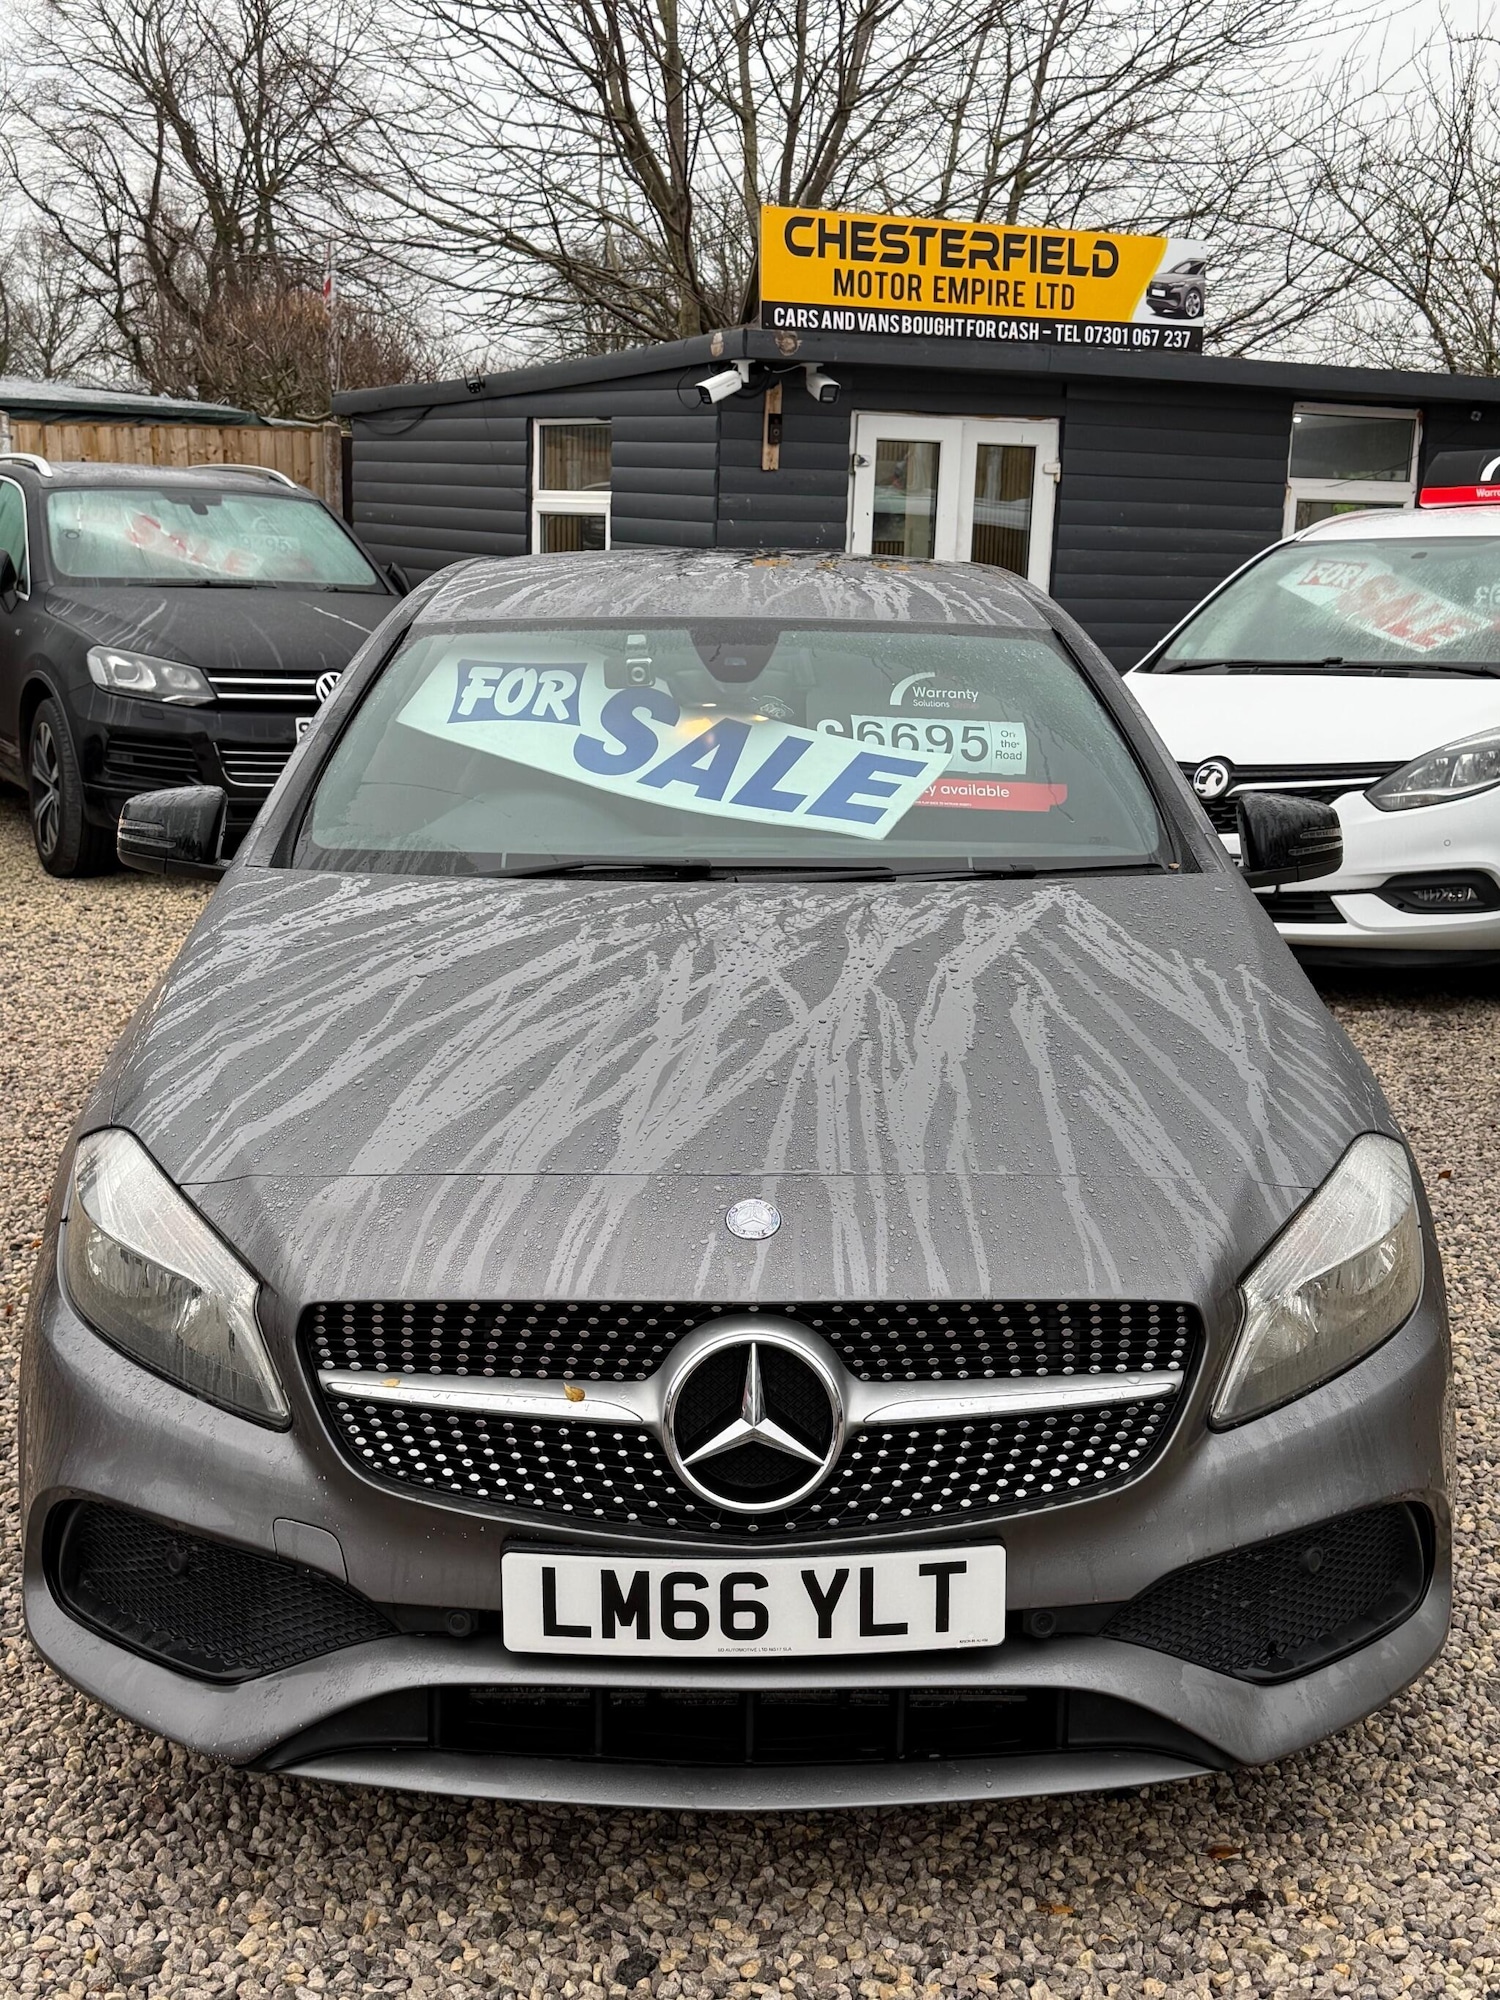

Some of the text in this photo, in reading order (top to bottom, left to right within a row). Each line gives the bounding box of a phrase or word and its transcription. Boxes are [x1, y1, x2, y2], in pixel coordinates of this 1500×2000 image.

[784, 216, 1120, 278] CHESTERFIELD
[833, 268, 1075, 311] MOTOR EMPIRE LTD
[773, 307, 819, 328] CARS
[821, 310, 855, 331] AND
[856, 312, 900, 333] VANS
[901, 315, 967, 337] BOUGHT
[967, 319, 997, 339] FOR
[998, 320, 1040, 341] CASH
[1055, 324, 1081, 343] TEL
[1084, 326, 1128, 345] 07301
[1132, 328, 1160, 347] 067
[1163, 330, 1191, 348] 237
[1302, 562, 1362, 589] FOR
[1337, 574, 1485, 648] SALE
[912, 686, 979, 703] Warranty
[912, 698, 951, 709] Solutions
[457, 666, 930, 824] FOR SALE
[1000, 730, 1016, 738] On
[995, 750, 1022, 760] Road
[941, 782, 1010, 798] available
[542, 1561, 967, 1641] LM66 YLT
